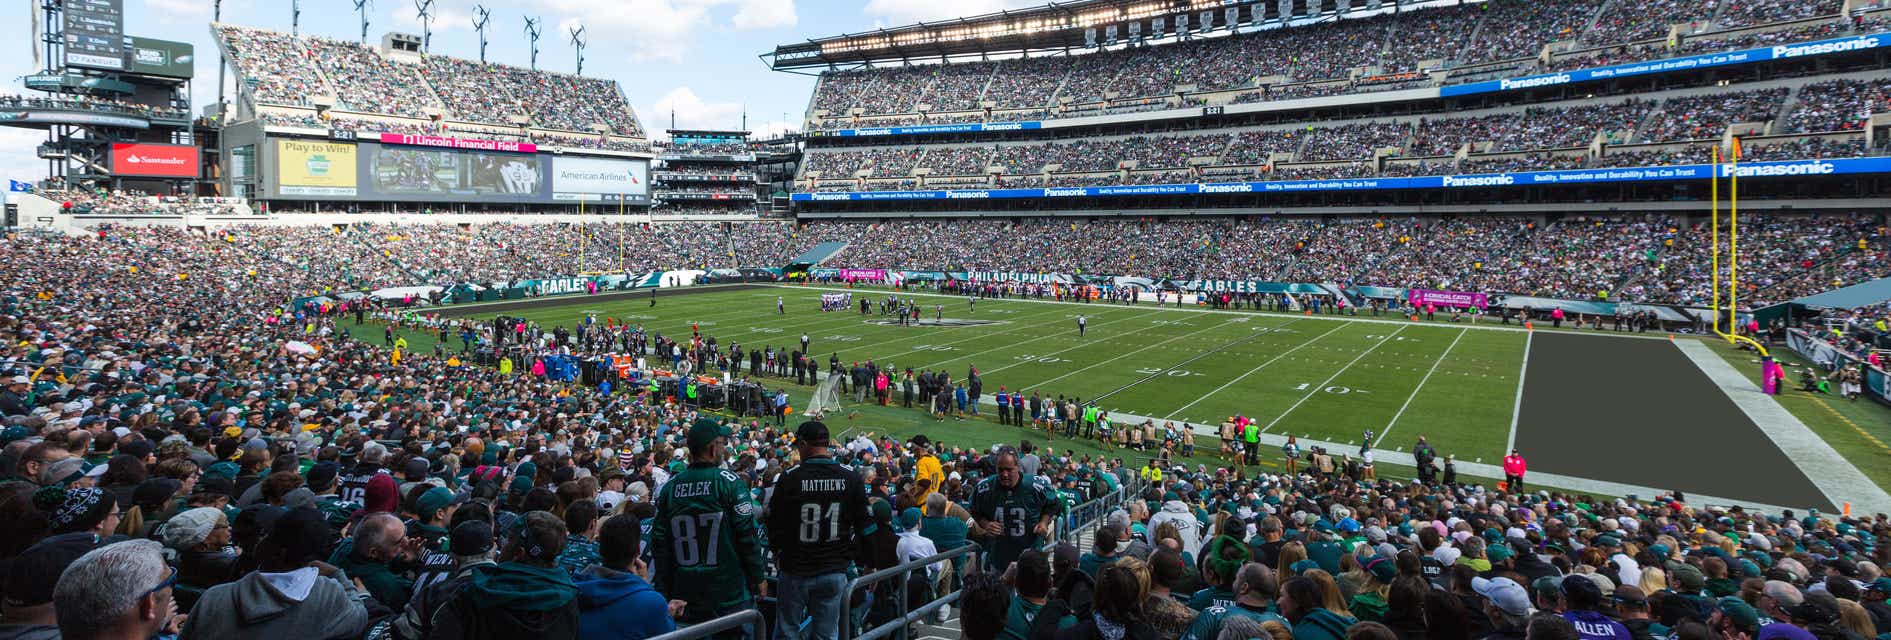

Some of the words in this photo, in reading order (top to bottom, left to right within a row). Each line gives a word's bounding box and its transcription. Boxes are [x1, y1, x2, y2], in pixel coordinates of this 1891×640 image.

[1773, 36, 1879, 59] Panasonic
[1616, 66, 1649, 74] Innovation
[1650, 63, 1663, 71] and
[1664, 60, 1697, 69] Durability
[1501, 73, 1570, 90] Panasonic
[855, 128, 892, 136] Panasonic
[982, 122, 1022, 131] Panasonic
[334, 130, 353, 139] 5:21
[285, 143, 309, 153] Play
[312, 144, 323, 152] to
[326, 145, 350, 153] Win!
[416, 136, 452, 147] Lincoln
[455, 139, 496, 150] Financial
[498, 142, 519, 151] Field
[141, 155, 185, 165] Santander
[1560, 172, 1593, 180] Innovation
[1609, 170, 1643, 180] Durability
[1659, 169, 1674, 177] Can
[1675, 168, 1695, 176] Trust
[1722, 161, 1834, 177] Panasonic
[561, 171, 598, 180] American
[600, 172, 626, 181] Airlines
[1443, 174, 1514, 187] Panasonic
[1044, 188, 1087, 197] Panasonic
[1199, 183, 1252, 193] Panasonic
[812, 192, 850, 200] Panasonic
[946, 190, 989, 199] Panasonic
[967, 271, 1051, 284] PHILADELPHIA
[801, 479, 846, 492] MATTHEWS
[799, 502, 841, 543] 81
[671, 511, 724, 567] 87
[1574, 620, 1616, 636] ALLEN
